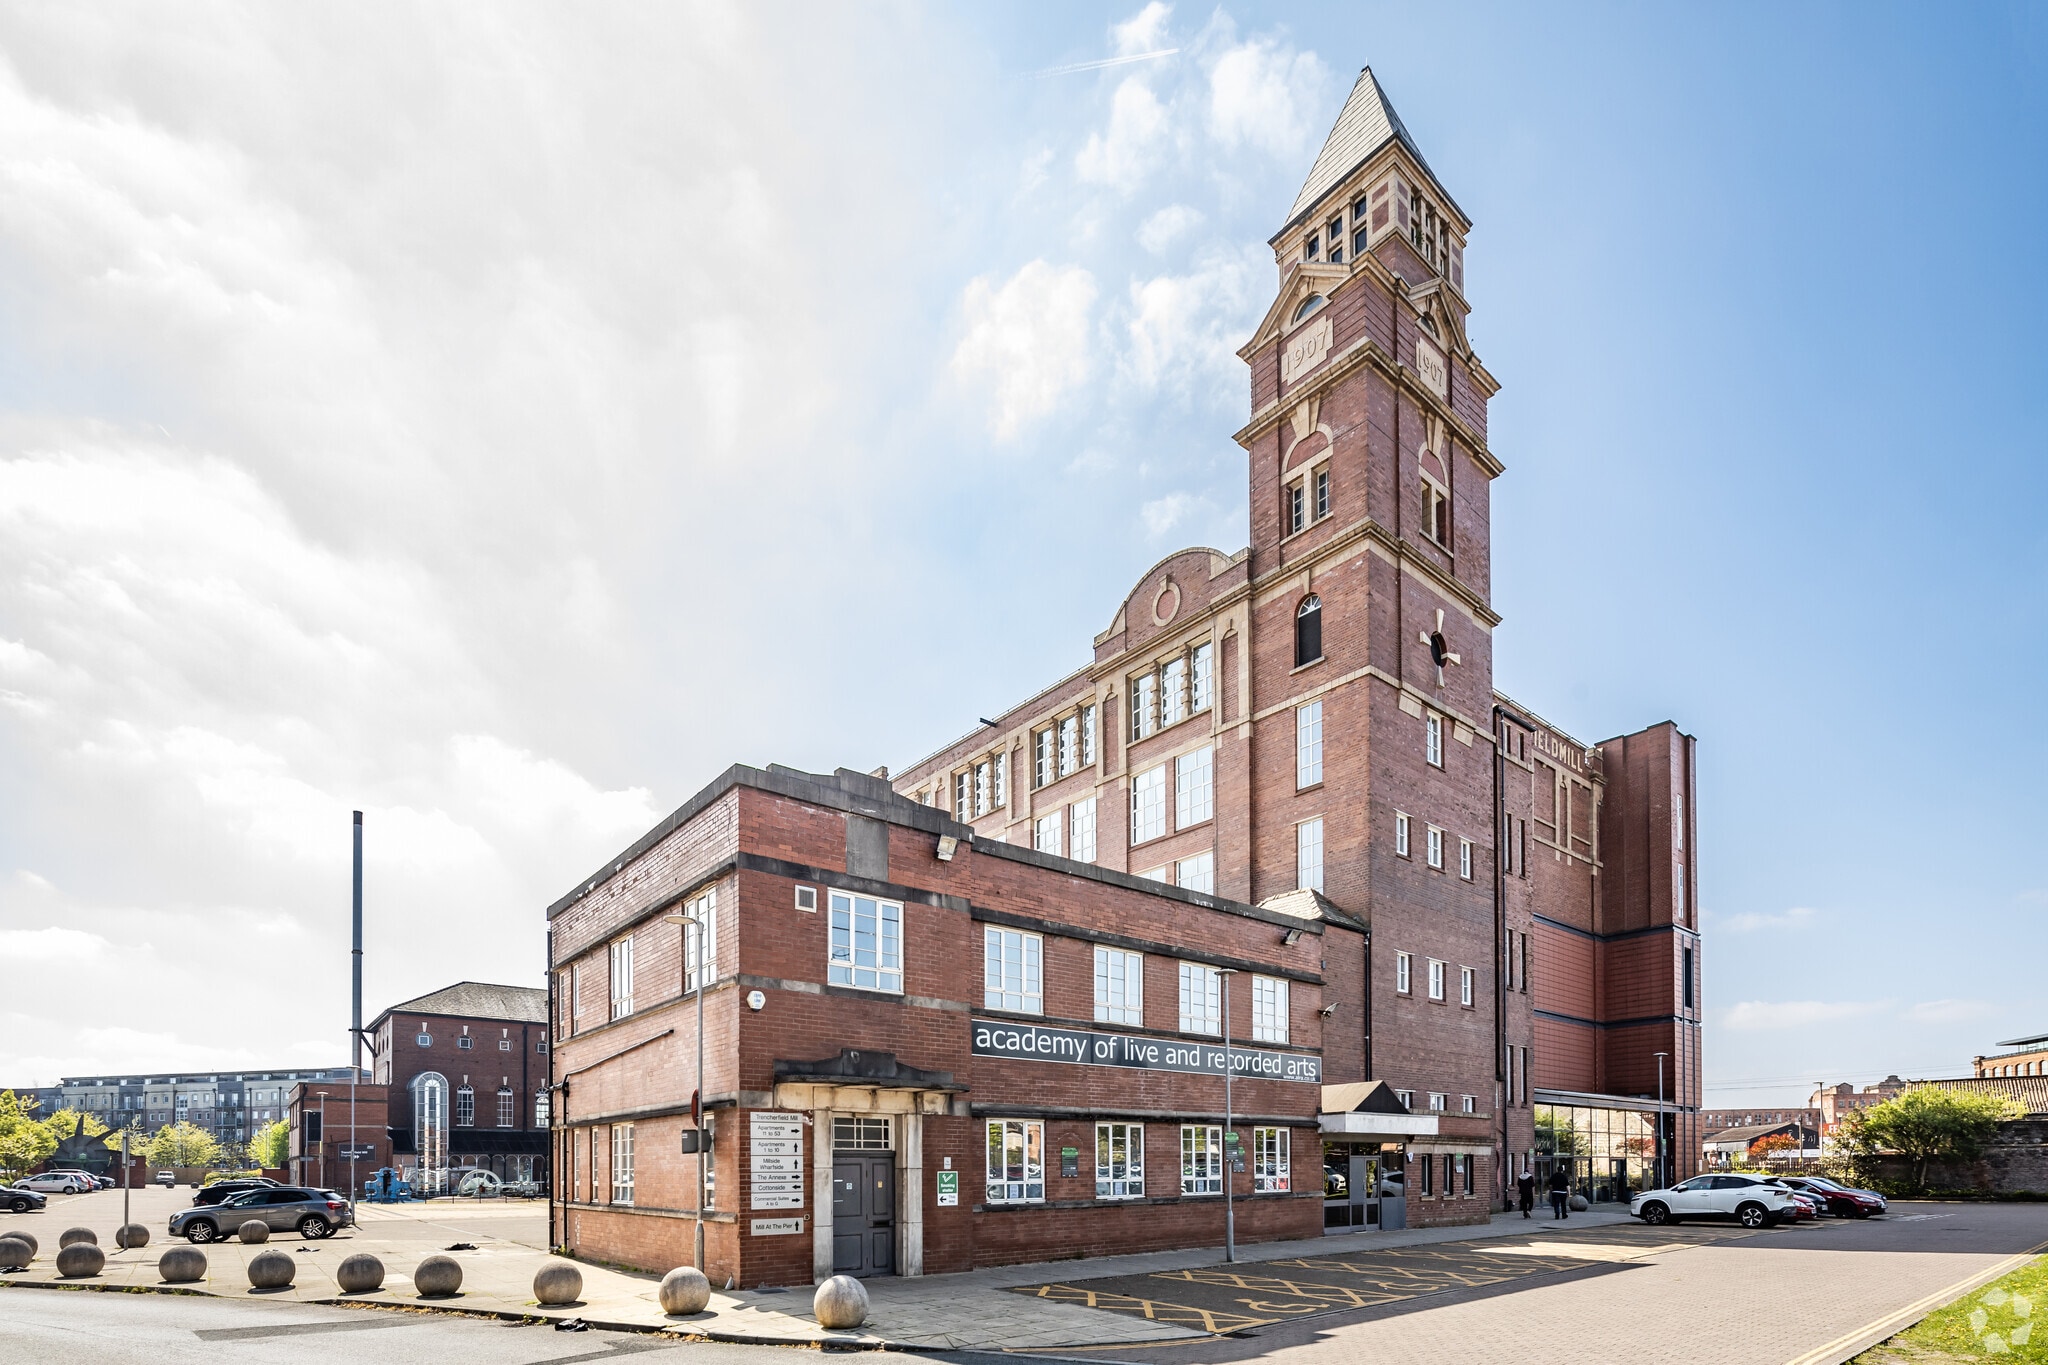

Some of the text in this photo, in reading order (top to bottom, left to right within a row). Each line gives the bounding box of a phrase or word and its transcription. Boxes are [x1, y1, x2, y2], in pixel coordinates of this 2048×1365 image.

[1284, 325, 1328, 375] 1907
[1417, 347, 1444, 387] 1907
[975, 1026, 1087, 1062] academy
[1095, 1036, 1117, 1059] of
[1124, 1039, 1159, 1063] live
[1166, 1045, 1200, 1067] and
[1287, 1058, 1316, 1077] arts
